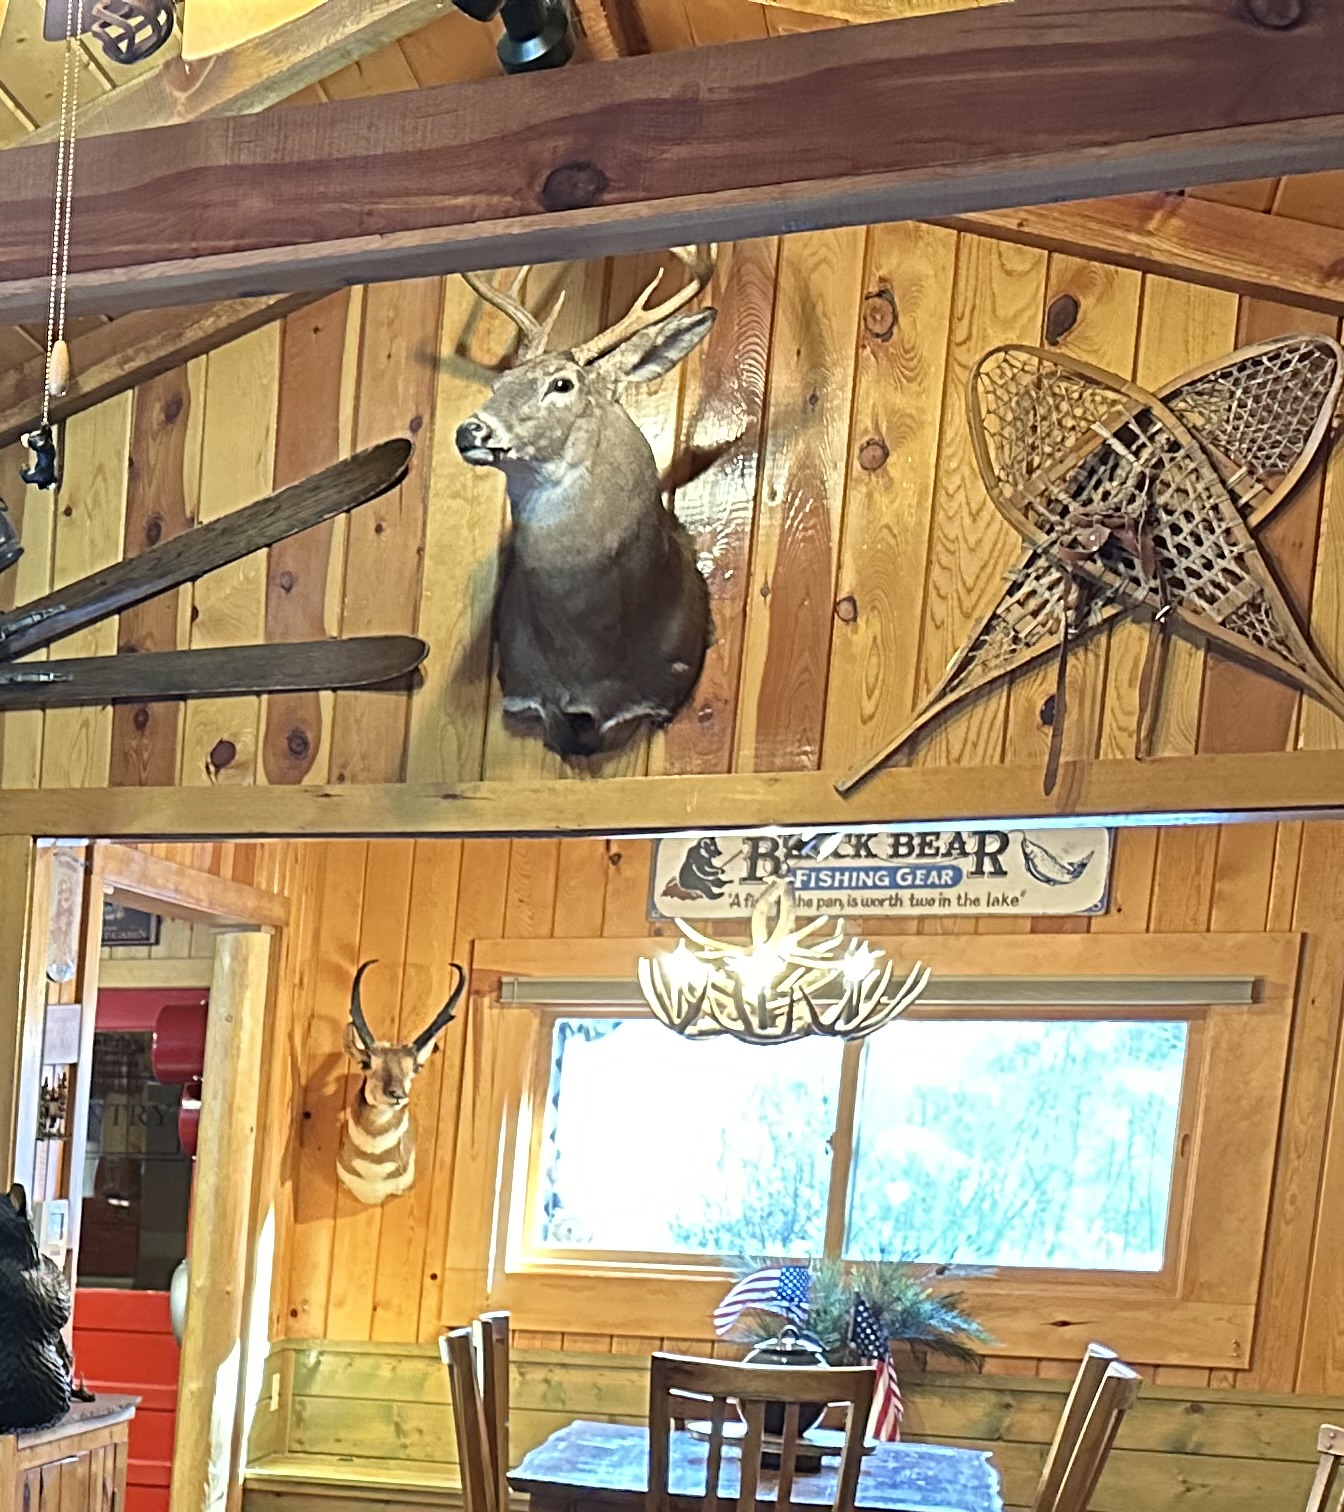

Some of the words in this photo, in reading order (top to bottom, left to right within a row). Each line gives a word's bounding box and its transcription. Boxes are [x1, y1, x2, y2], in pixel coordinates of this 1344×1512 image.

[888, 831, 1010, 879] BEAR
[794, 868, 890, 888] FISHING
[895, 867, 953, 887] GEAR
[847, 894, 858, 908] is
[861, 892, 903, 908] worth
[908, 892, 936, 907] two
[938, 892, 951, 907] in
[956, 892, 980, 907] the
